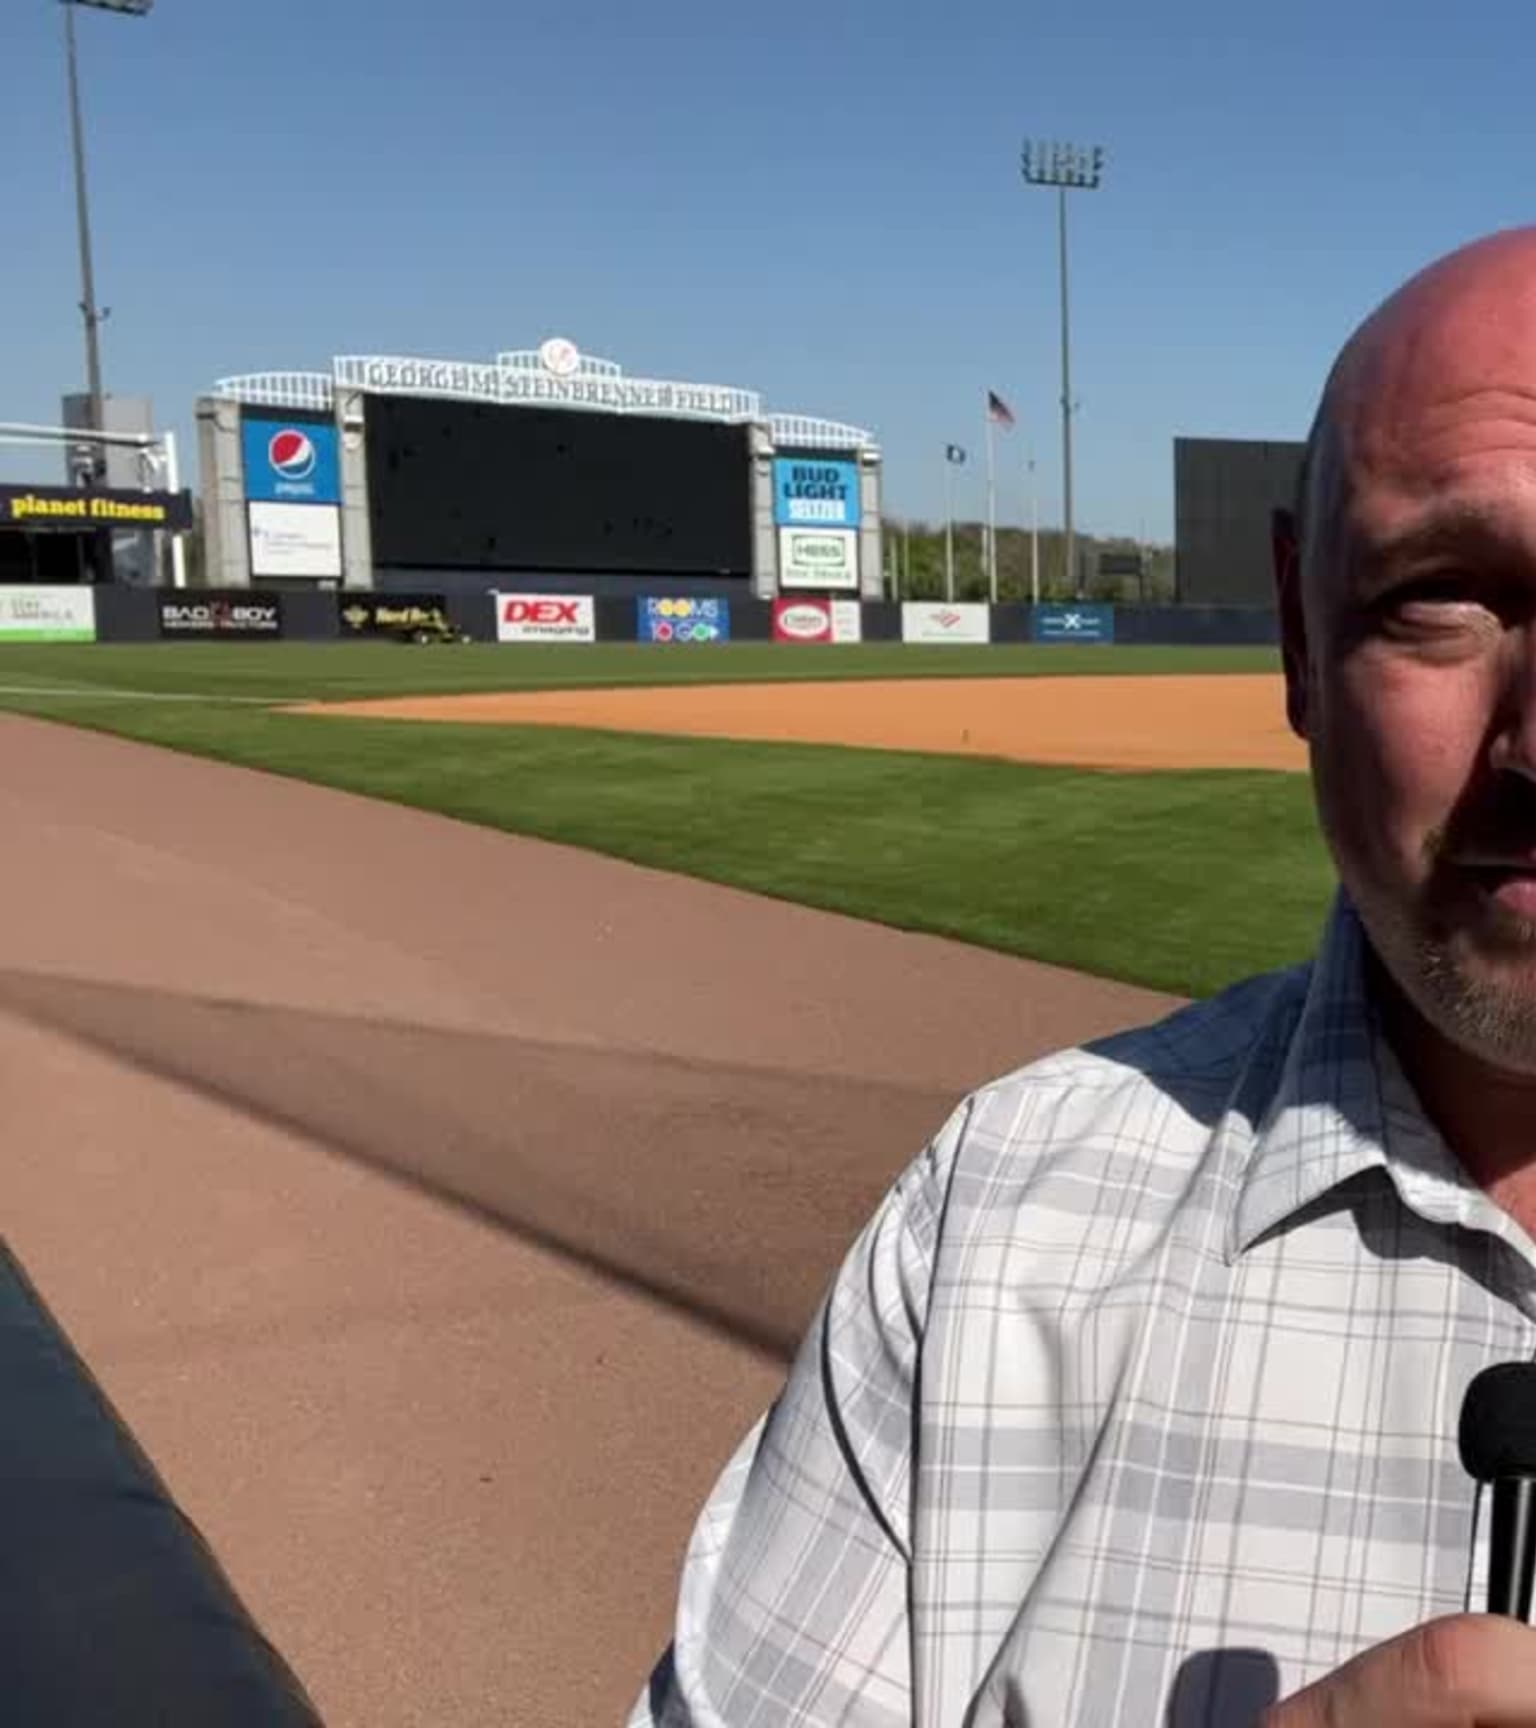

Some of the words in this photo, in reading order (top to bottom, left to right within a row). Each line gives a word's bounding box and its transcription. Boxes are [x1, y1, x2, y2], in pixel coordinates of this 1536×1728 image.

[676, 389, 733, 415] FIELD
[792, 465, 840, 483] BUD
[783, 481, 847, 501] LIGHT
[11, 494, 87, 519] planet
[91, 499, 165, 521] fitness
[162, 605, 210, 621] BAD
[232, 605, 277, 621] BOY
[503, 601, 577, 623] DEX
[648, 598, 719, 618] ROOMS
